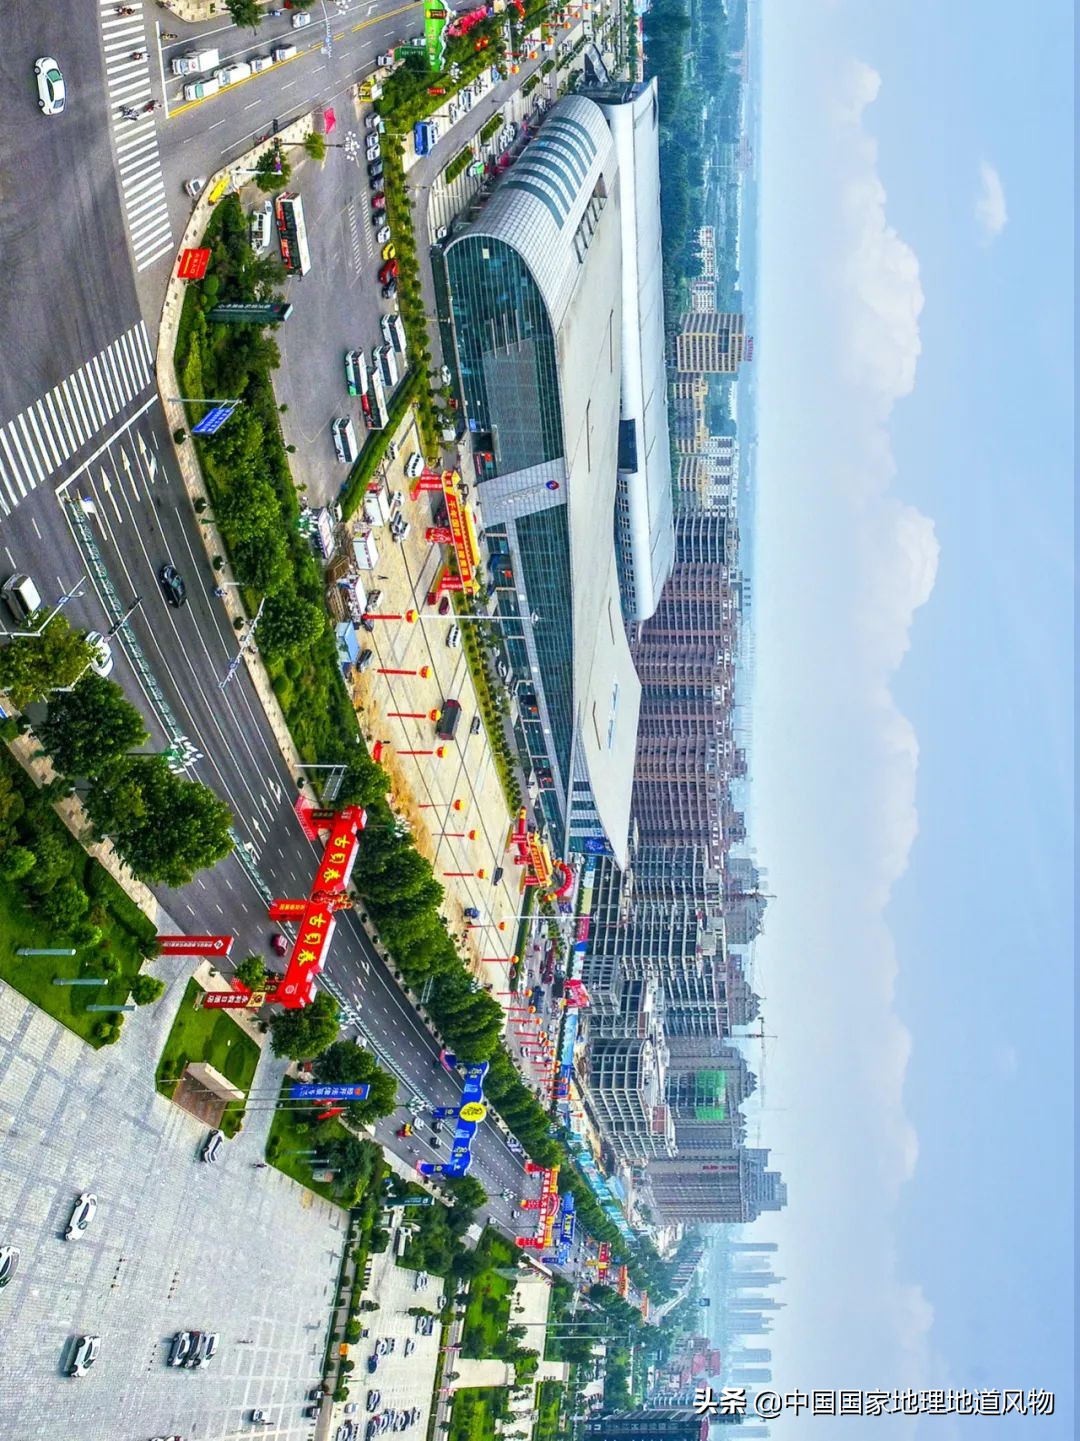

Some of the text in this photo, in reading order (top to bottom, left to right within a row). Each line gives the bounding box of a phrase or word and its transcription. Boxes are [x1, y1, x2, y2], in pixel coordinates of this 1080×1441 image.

[323, 834, 350, 883] 古贝春
[298, 913, 326, 967] 古贝春
